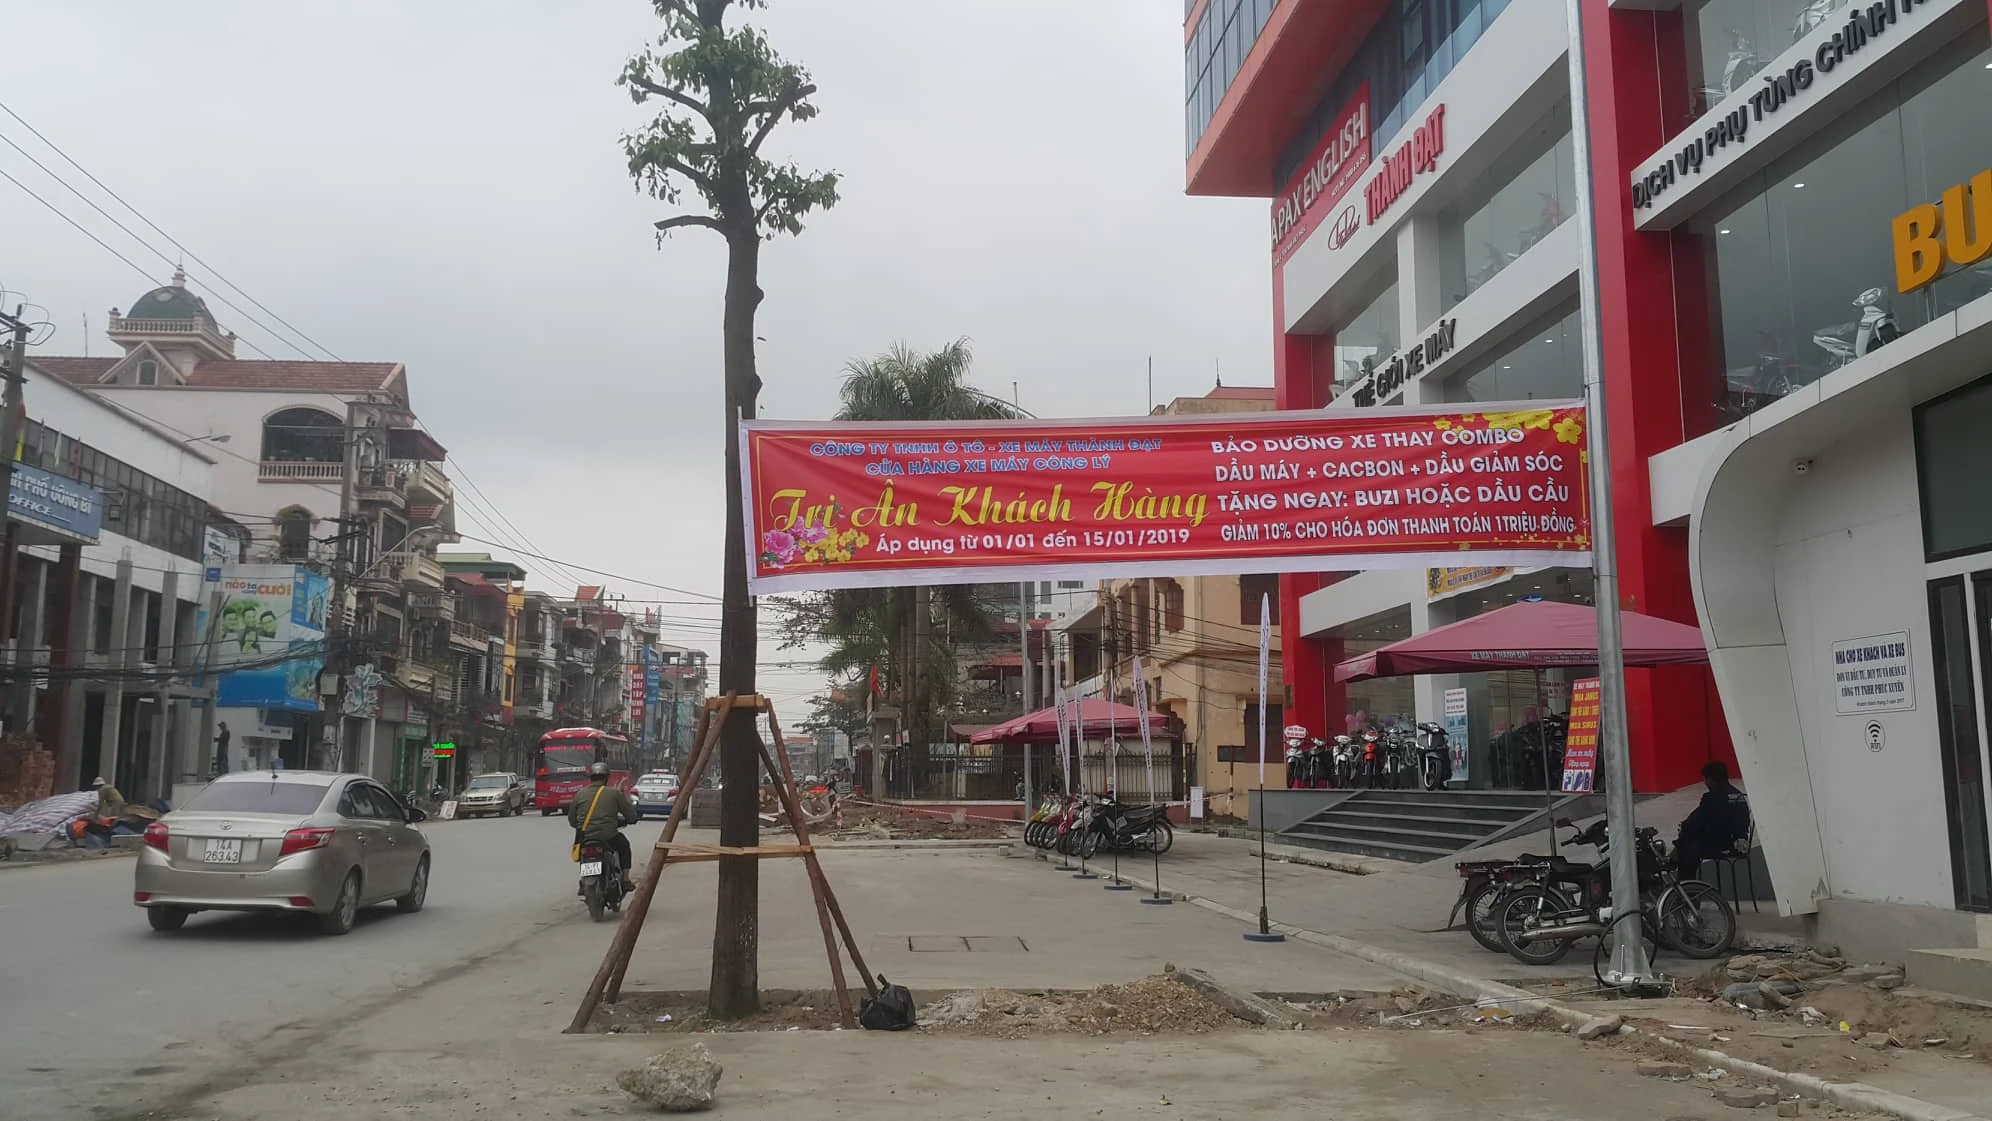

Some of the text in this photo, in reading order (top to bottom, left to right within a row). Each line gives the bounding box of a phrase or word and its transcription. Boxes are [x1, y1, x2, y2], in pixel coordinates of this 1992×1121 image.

[1632, 0, 1897, 209] DỊCH VỤ PHỤ TÙNG CHÍNH
[1270, 183, 1306, 248] APAX
[1303, 102, 1367, 210] ENGLISH
[1363, 103, 1446, 226] THÀNH ĐẠT
[1376, 356, 1404, 398] GIỚI
[1404, 344, 1424, 380] XE
[1424, 318, 1456, 366] MÁY
[810, 440, 865, 457] CÔNG
[868, 442, 889, 455] TY
[892, 442, 940, 455] TNHH
[943, 439, 958, 454] Ô
[963, 439, 985, 454] TÔ
[999, 441, 1021, 453] XE
[1024, 438, 1063, 453] MÁY
[1066, 437, 1125, 453] THÀNH
[1127, 438, 1162, 452] ĐẠT
[1210, 427, 1525, 454] BẢO DƯỠNG XE THAY COMBO
[865, 453, 1111, 476] CỬA HÀNG XE MÁY CÔNG LÝ
[1215, 450, 1564, 483] DẦU MÁY + CACBON + DẦU GIẢM SÓC
[769, 478, 1211, 531] Tri Ân Khách Hàng
[1216, 476, 1569, 516] TẶNG NGAY: BUZI HOẶC DẦU CẦU
[876, 528, 1191, 556] Áp dụng từ 01/01 đến 15/01/2019
[1221, 518, 1259, 542] GIẢM
[1263, 522, 1292, 540] 10%
[1295, 521, 1328, 539] CHO
[1331, 516, 1364, 537] HÓA
[1367, 516, 1399, 537] ĐƠN
[1402, 516, 1450, 535] THANH
[1452, 511, 1491, 534] TOÁN
[1540, 507, 1576, 534] ĐỒNG
